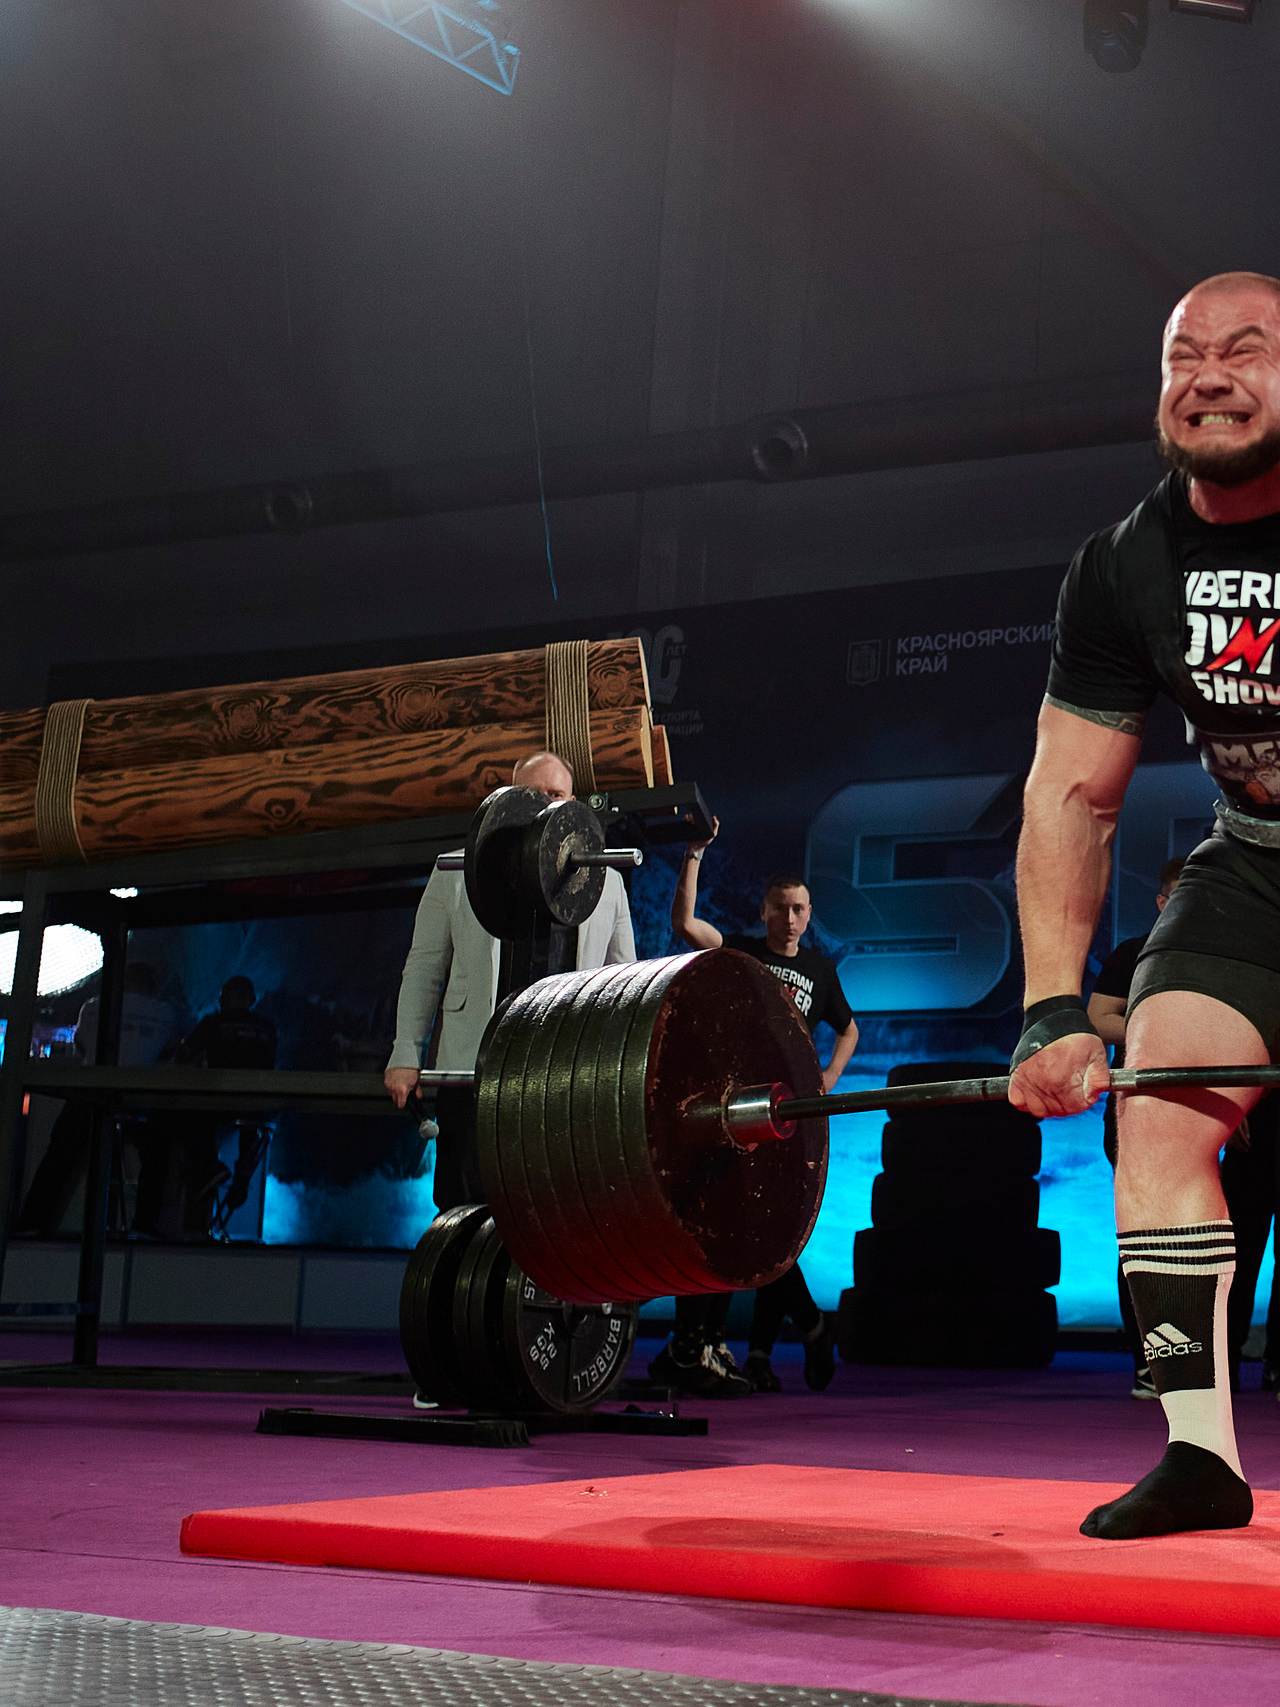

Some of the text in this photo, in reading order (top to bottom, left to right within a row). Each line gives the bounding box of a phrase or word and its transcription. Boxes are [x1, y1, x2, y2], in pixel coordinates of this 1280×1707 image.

[896, 651, 948, 677] КРАЙ
[764, 964, 814, 995] BERIAN
[529, 1321, 556, 1362] KGS
[573, 1318, 622, 1392] BARBELL
